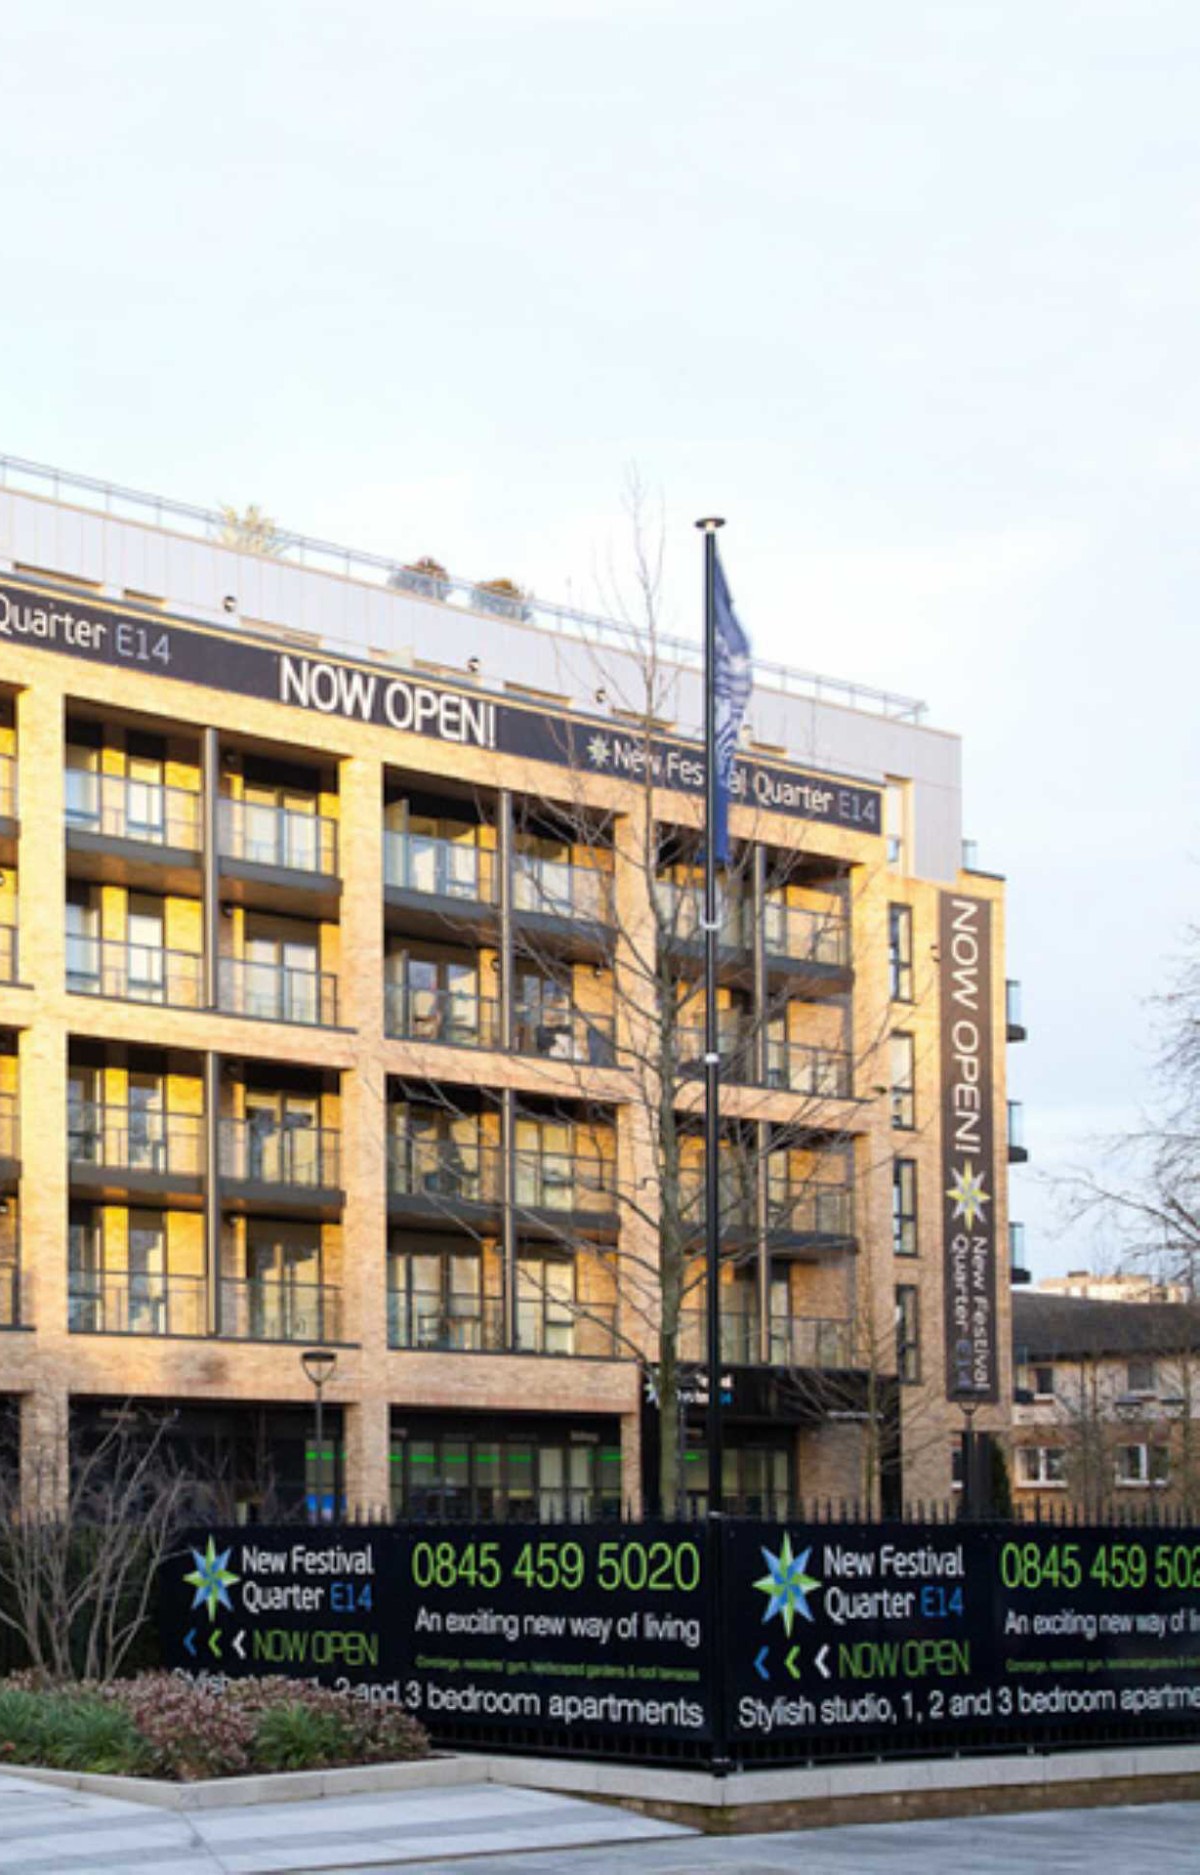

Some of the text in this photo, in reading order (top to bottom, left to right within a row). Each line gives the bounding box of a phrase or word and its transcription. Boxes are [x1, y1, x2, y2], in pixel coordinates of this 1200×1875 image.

[115, 624, 172, 665] E14
[280, 654, 496, 750] NOW OPEN!
[666, 751, 747, 797] Fesal
[753, 770, 834, 813] Quarter
[838, 791, 876, 824] E14
[952, 899, 981, 1154] NOW OPEN!
[951, 1233, 970, 1333] Quarter
[971, 1236, 991, 1391] New Festival
[242, 1544, 375, 1575] New Festival
[411, 1541, 700, 1591] 0845 459 5020
[823, 1544, 965, 1577] New Festival
[1001, 1542, 1082, 1588] 0845
[1090, 1543, 1147, 1589] 459
[242, 1581, 372, 1613] Quarter E14
[824, 1586, 964, 1625] Quarter E14
[415, 1607, 700, 1648] An exciting new way of living
[1004, 1608, 1029, 1635] An
[1033, 1608, 1097, 1640] exciting
[1100, 1614, 1132, 1634] new
[253, 1629, 379, 1666] NOW OPEN
[839, 1641, 899, 1679] NOW
[902, 1639, 971, 1677] OPEN
[405, 1680, 422, 1709] 3
[427, 1682, 541, 1715] bedroom
[549, 1693, 704, 1728] apartments
[739, 1695, 816, 1735] Stylish
[820, 1693, 898, 1725] studio,
[928, 1690, 944, 1718] 2
[949, 1687, 993, 1716] and
[997, 1686, 1013, 1715] 3
[1018, 1686, 1116, 1714] bedroom
